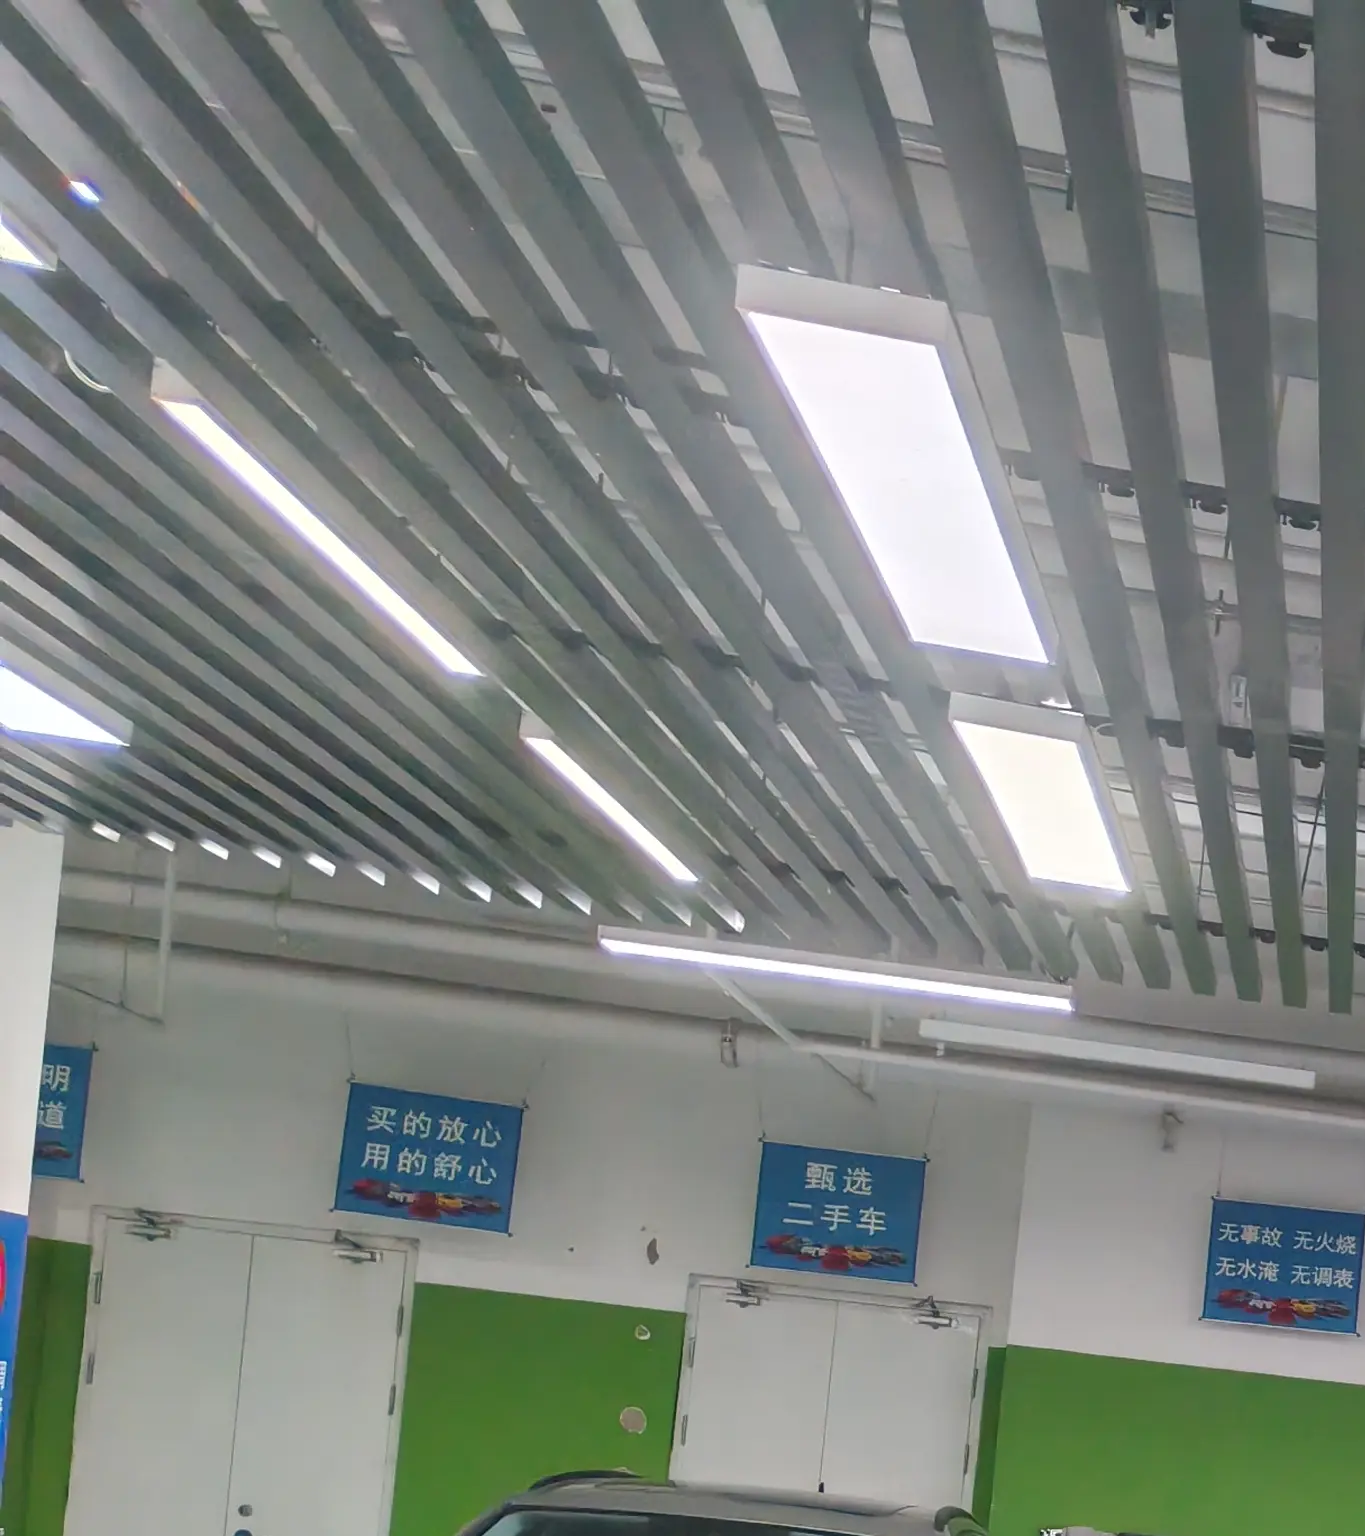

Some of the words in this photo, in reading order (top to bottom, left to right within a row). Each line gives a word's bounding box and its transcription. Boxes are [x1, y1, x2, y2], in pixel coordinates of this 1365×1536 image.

[42, 1064, 71, 1091] 明
[38, 1101, 66, 1129] 道
[366, 1105, 502, 1148] 买的放心
[361, 1142, 497, 1185] 用的舒心
[804, 1161, 874, 1195] 甄选
[783, 1202, 887, 1236] 二手车
[1217, 1222, 1283, 1248] 无事故
[1292, 1230, 1357, 1256] 无火烧
[1215, 1256, 1280, 1282] 无水淹
[1290, 1265, 1355, 1289] 无调表
